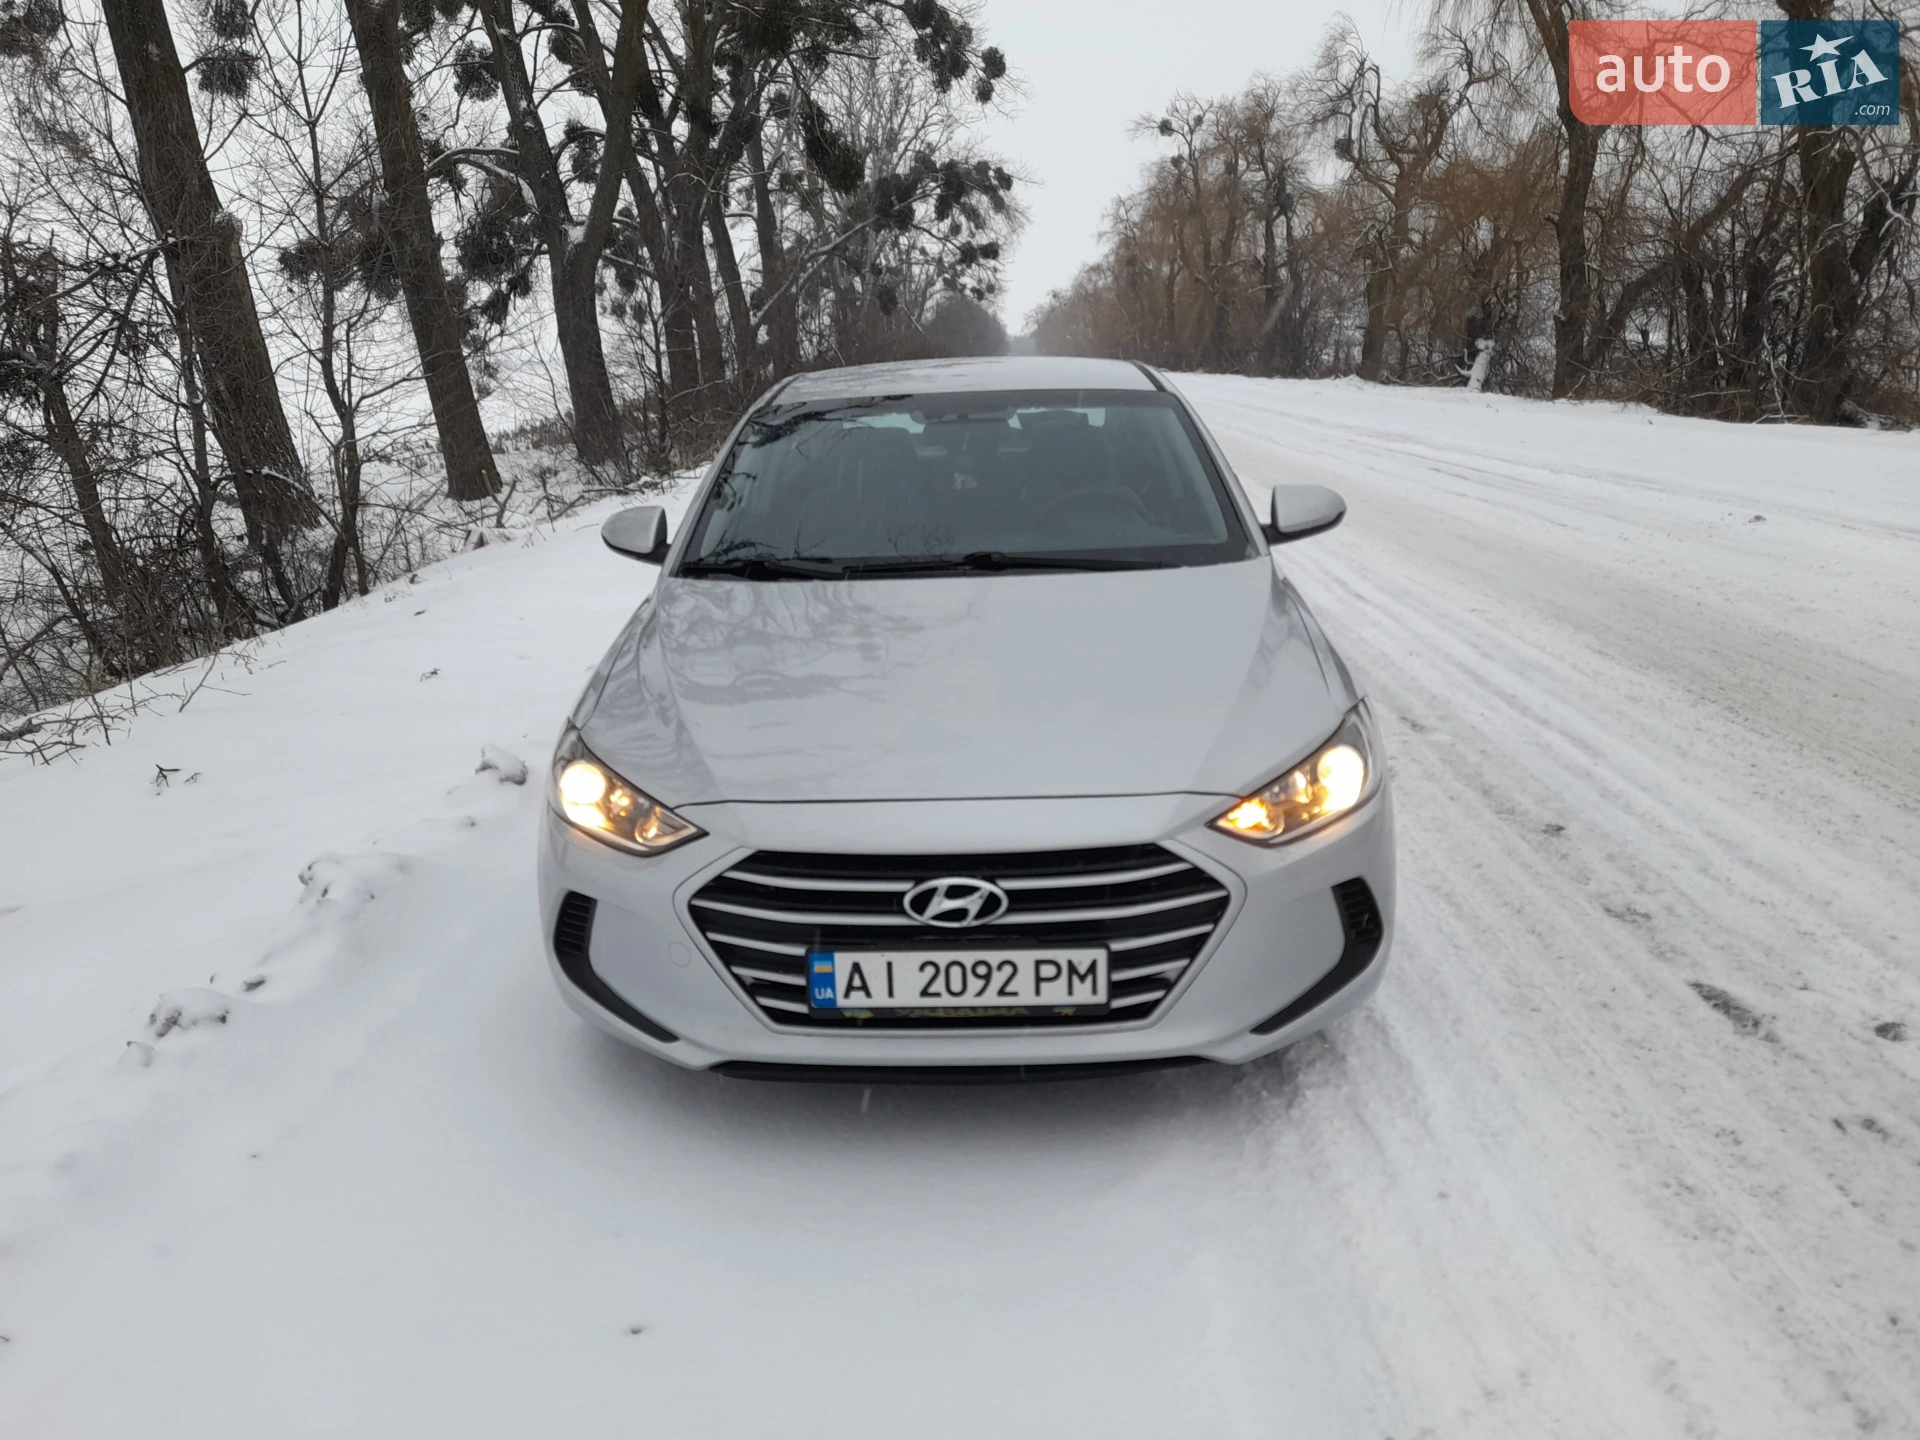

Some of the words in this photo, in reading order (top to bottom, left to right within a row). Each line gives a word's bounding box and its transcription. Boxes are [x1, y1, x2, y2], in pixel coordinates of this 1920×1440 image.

[843, 960, 895, 999] AI
[918, 960, 1019, 998] 2092
[1034, 959, 1098, 997] PM
[814, 987, 835, 1000] UA
